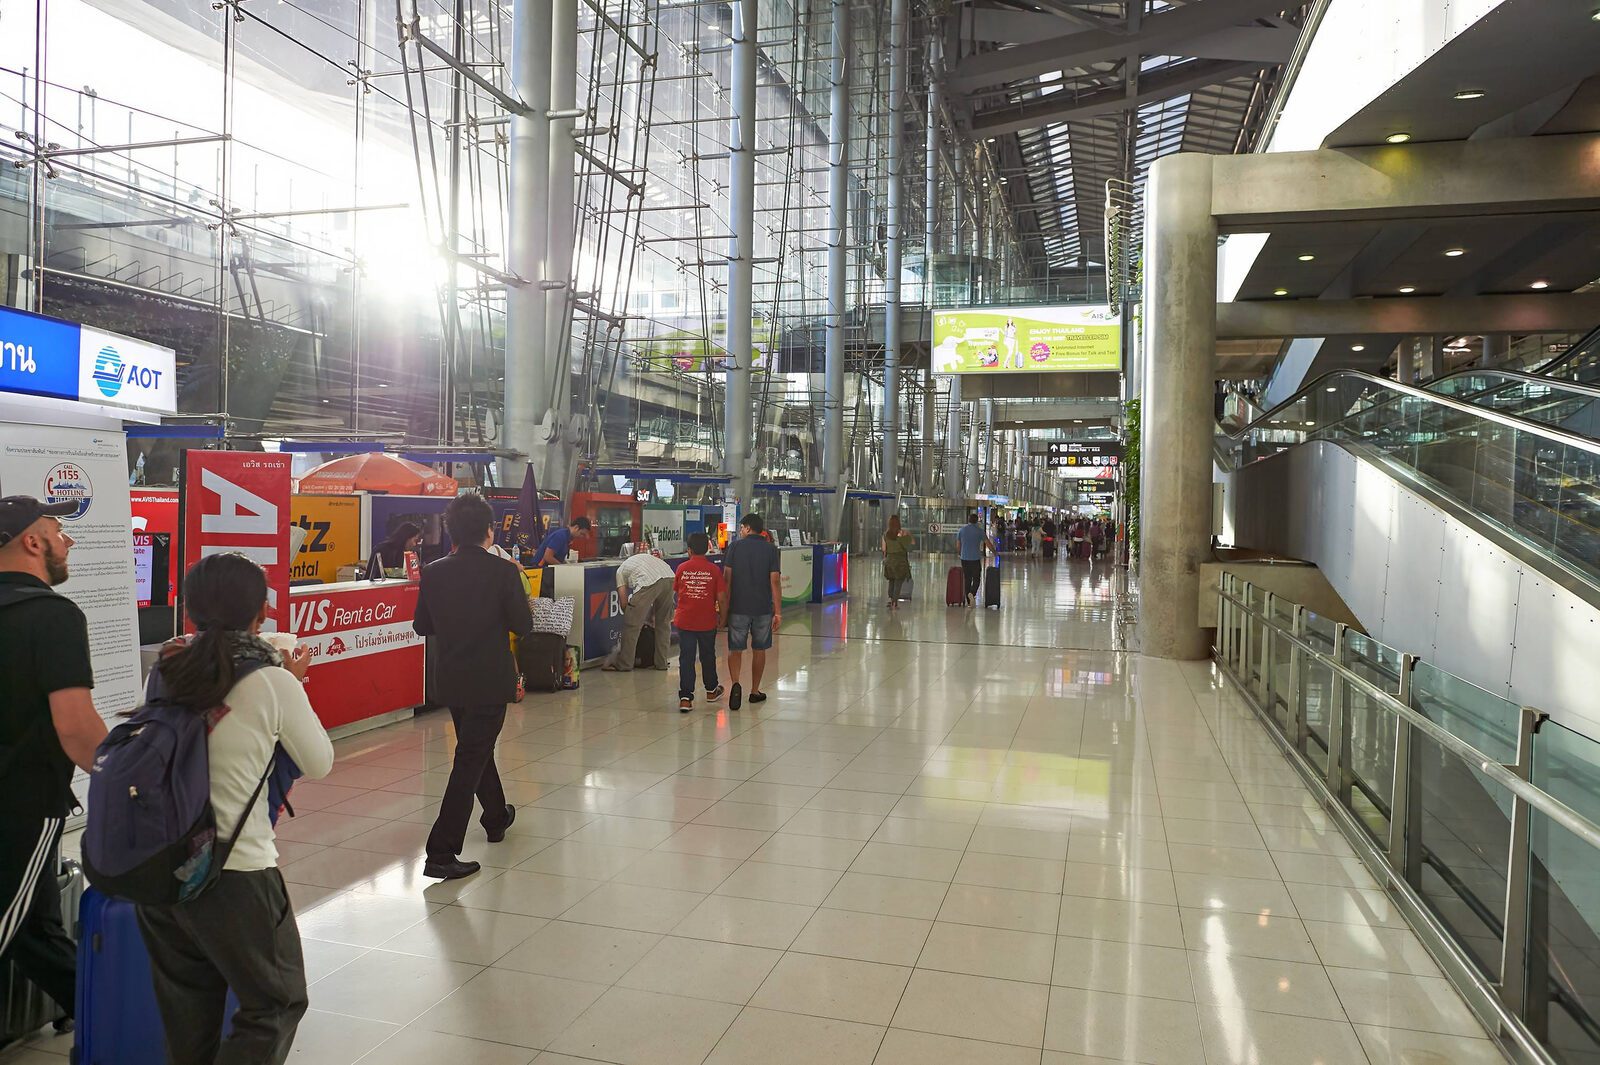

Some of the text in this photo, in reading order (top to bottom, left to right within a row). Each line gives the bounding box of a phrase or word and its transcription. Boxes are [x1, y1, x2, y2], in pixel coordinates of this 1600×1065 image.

[127, 365, 162, 390] AOT
[57, 469, 79, 481] 1155
[133, 535, 150, 545] VIS
[653, 526, 682, 541] National
[289, 599, 397, 634] VIS Rent a Car
